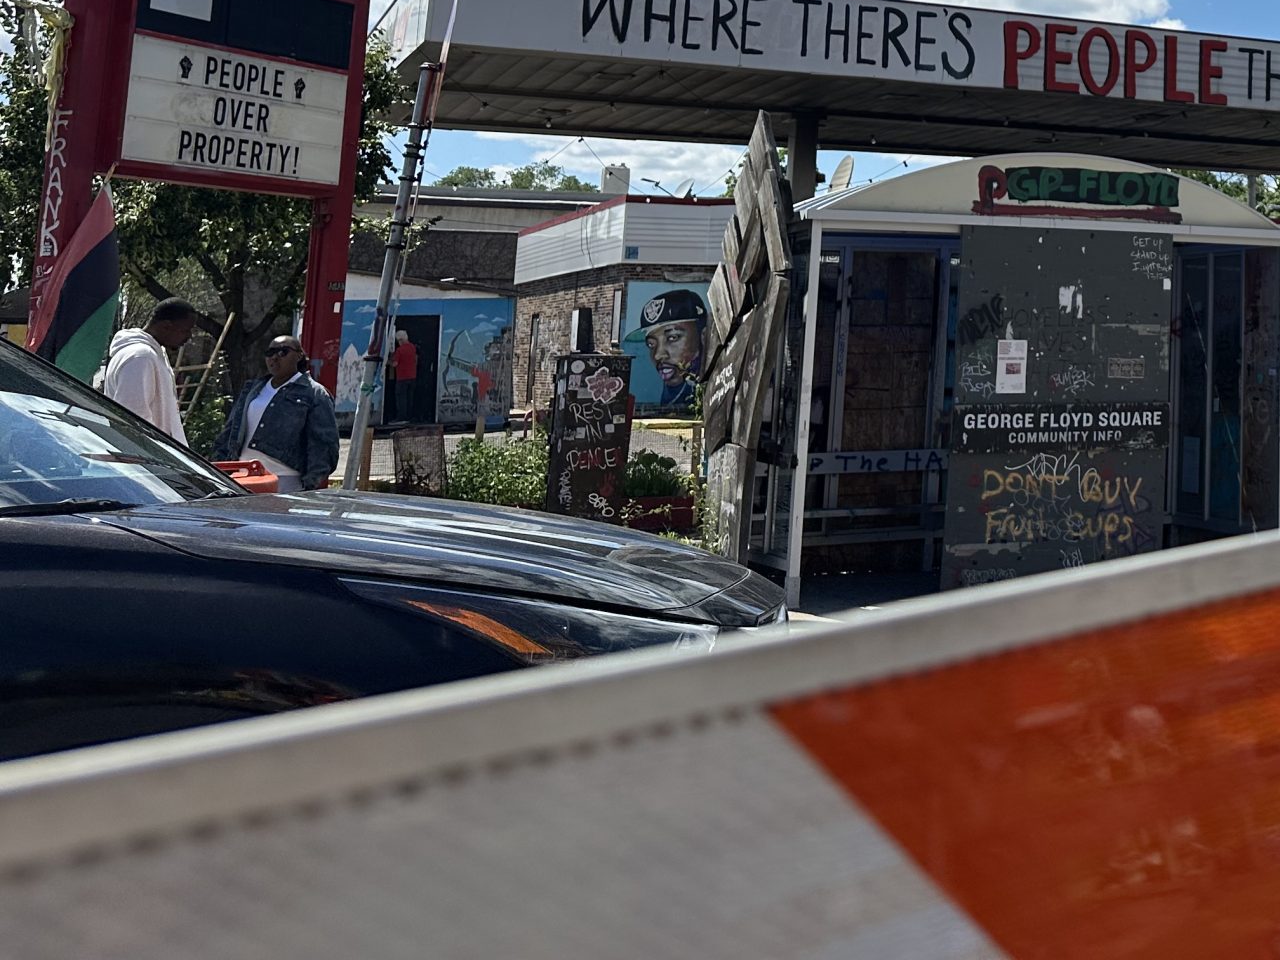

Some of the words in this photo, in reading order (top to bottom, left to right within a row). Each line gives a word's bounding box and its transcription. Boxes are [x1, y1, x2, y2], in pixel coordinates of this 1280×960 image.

[204, 55, 286, 98] PEOPLE
[1002, 20, 1229, 106] PEOPLE
[213, 96, 271, 133] OVER
[177, 130, 300, 175] PROPERTY!
[964, 413, 1034, 429] GEORGE
[1040, 412, 1093, 428] FLOYD
[1098, 411, 1162, 427] SQUARE
[1008, 431, 1089, 443] COMMUNITY
[1094, 430, 1122, 442] INFO
